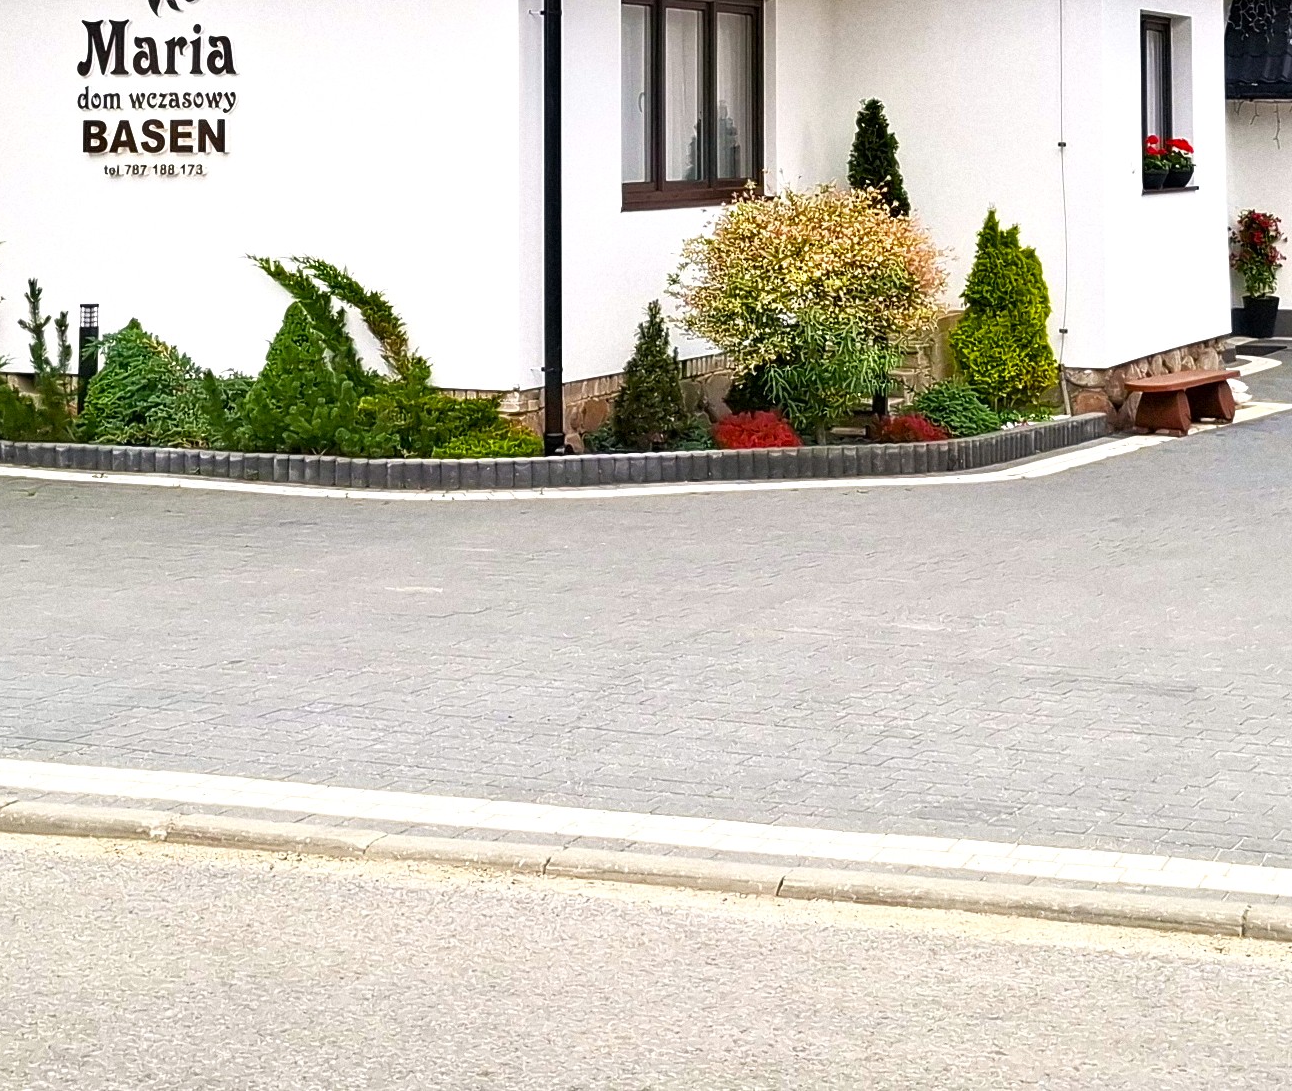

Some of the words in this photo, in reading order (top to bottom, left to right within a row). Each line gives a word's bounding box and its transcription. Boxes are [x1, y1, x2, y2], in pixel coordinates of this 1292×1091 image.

[76, 19, 237, 77] Maria
[77, 86, 122, 110] dom
[128, 91, 237, 113] wczasowy
[82, 118, 226, 153] BASEN
[124, 164, 148, 175] 787
[152, 163, 176, 175] 188
[180, 163, 204, 175] 173
